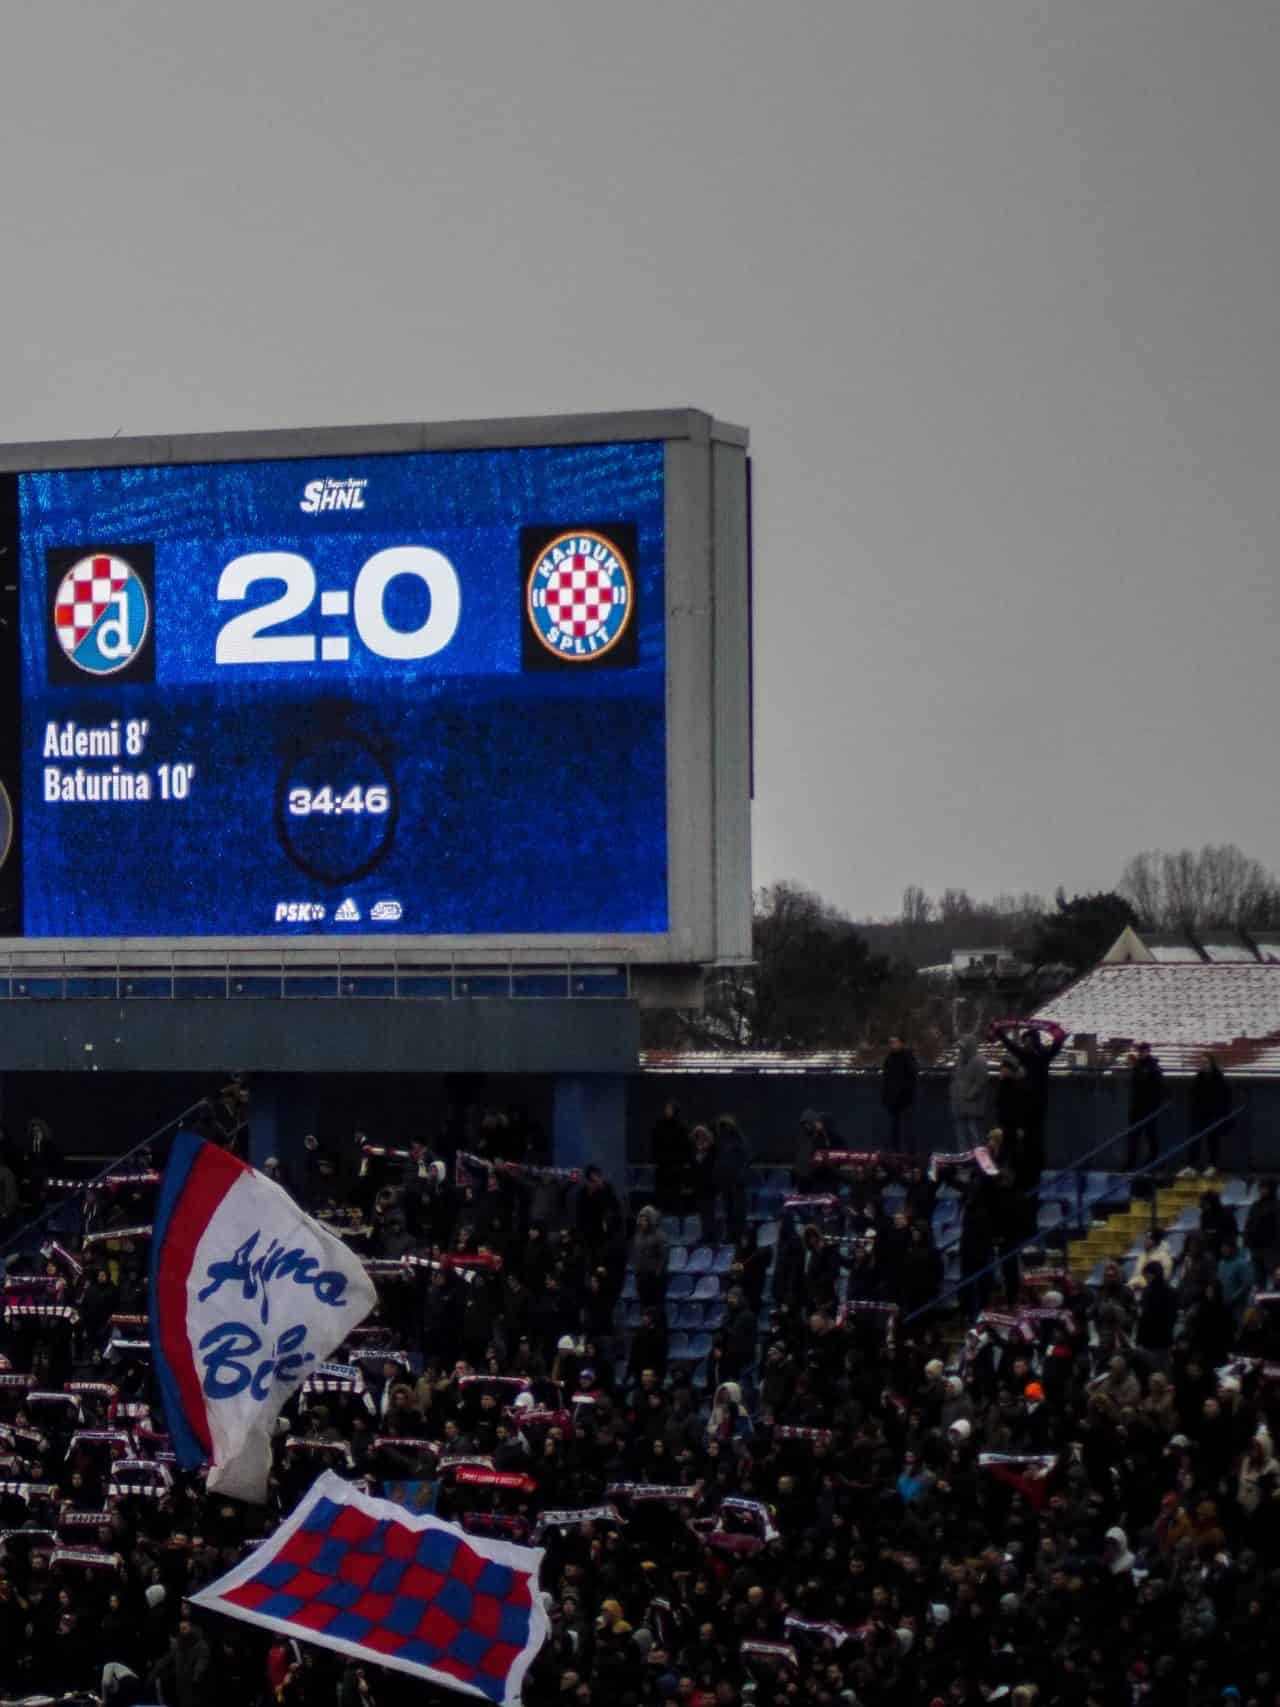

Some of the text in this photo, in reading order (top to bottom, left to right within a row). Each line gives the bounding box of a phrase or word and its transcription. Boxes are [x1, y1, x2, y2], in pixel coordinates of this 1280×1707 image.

[300, 480, 365, 512] SHNL
[539, 539, 618, 578] HAJDUK
[215, 546, 461, 664] 2:0
[547, 625, 609, 653] SPLIT
[43, 720, 149, 758] Ademi 8'
[44, 763, 195, 801] Baturina 10'
[288, 787, 389, 815] 34:46
[275, 902, 313, 922] PSK
